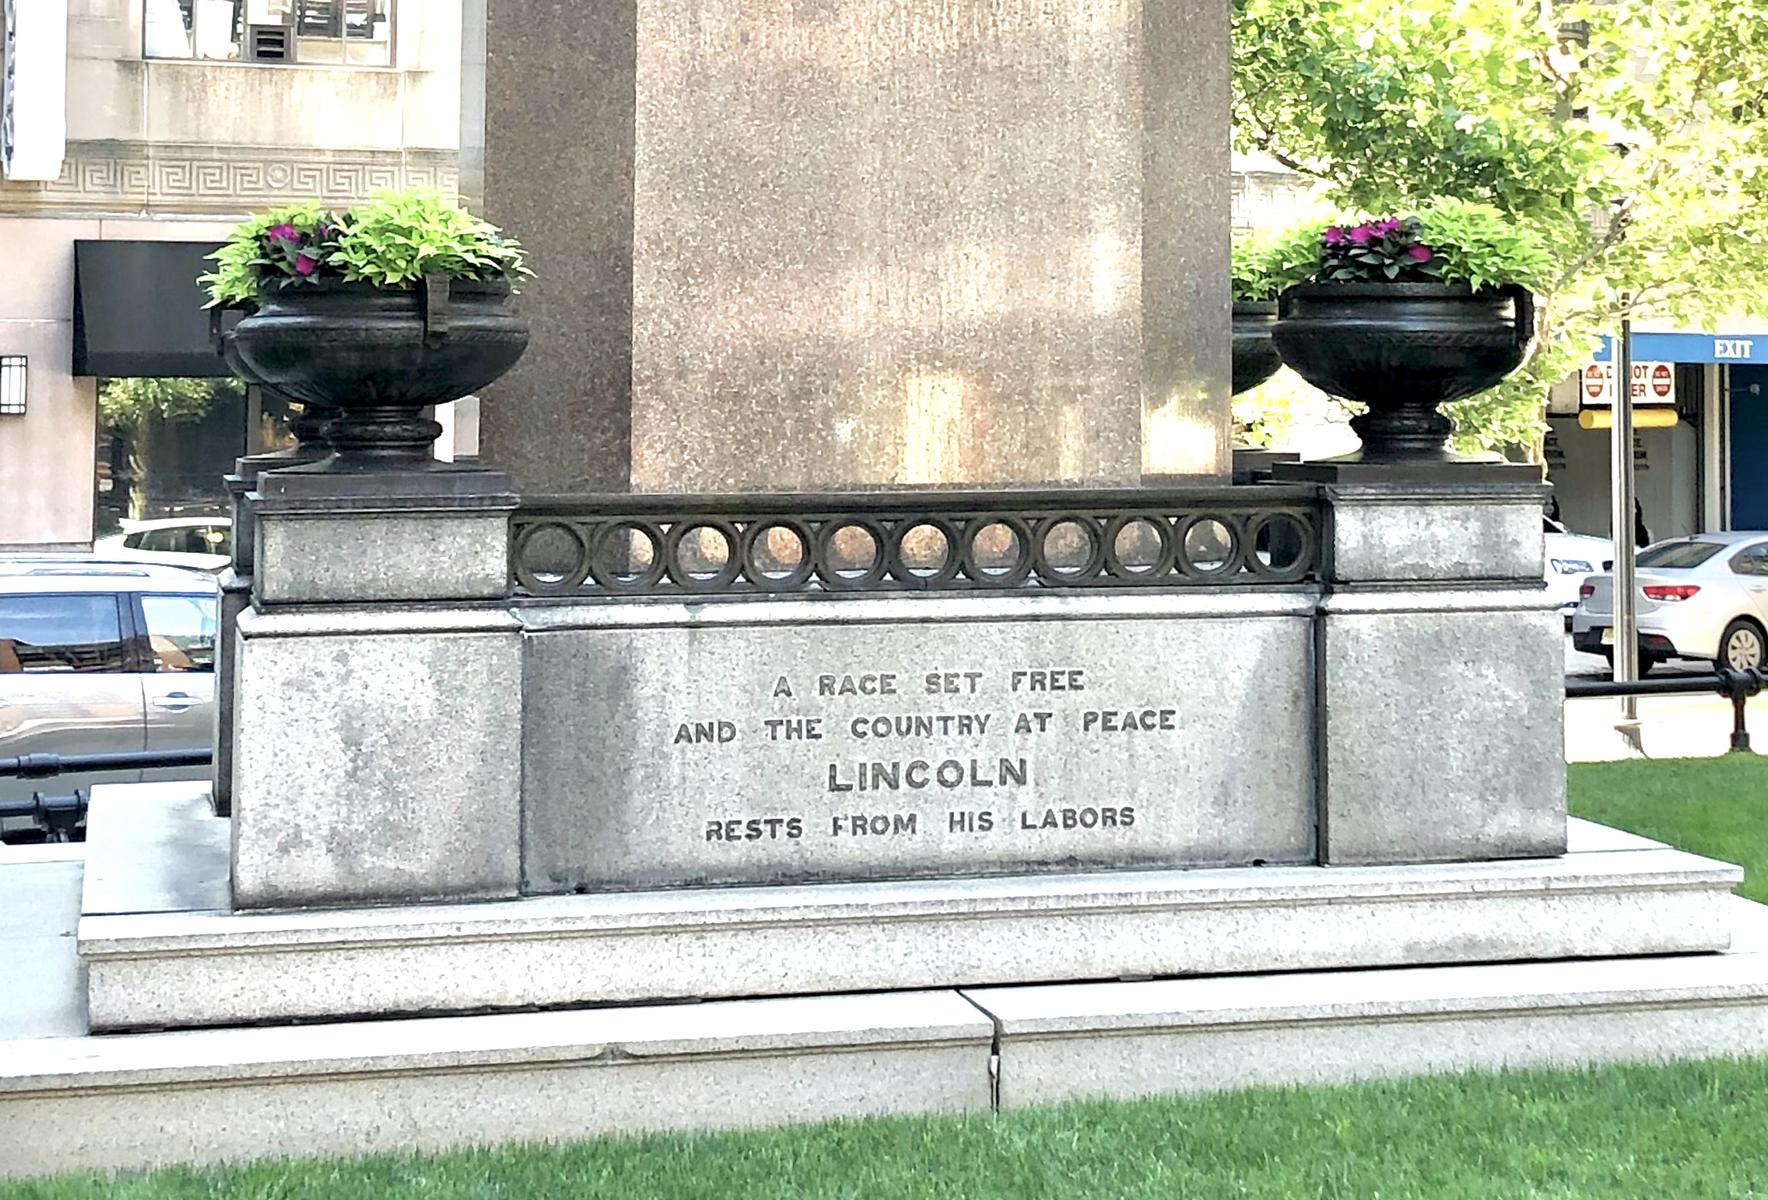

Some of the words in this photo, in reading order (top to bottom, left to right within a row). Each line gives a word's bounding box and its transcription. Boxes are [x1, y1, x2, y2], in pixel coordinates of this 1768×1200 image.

[1714, 339, 1753, 359] EXIT
[1630, 365, 1649, 379] OT
[773, 676, 792, 697] A
[819, 674, 897, 696] RACE
[925, 672, 983, 694] SET
[1011, 670, 1084, 692] FREE
[674, 721, 736, 744] AND
[764, 719, 822, 741] THE
[851, 714, 991, 738] COUNTRY
[1015, 712, 1053, 734] AT
[1083, 710, 1176, 733] PEACE
[828, 758, 1027, 792] LINCOLN
[706, 817, 803, 841] RESTS
[832, 813, 917, 836] FROM
[949, 811, 994, 833] HIS
[1021, 807, 1135, 830] LABORS
